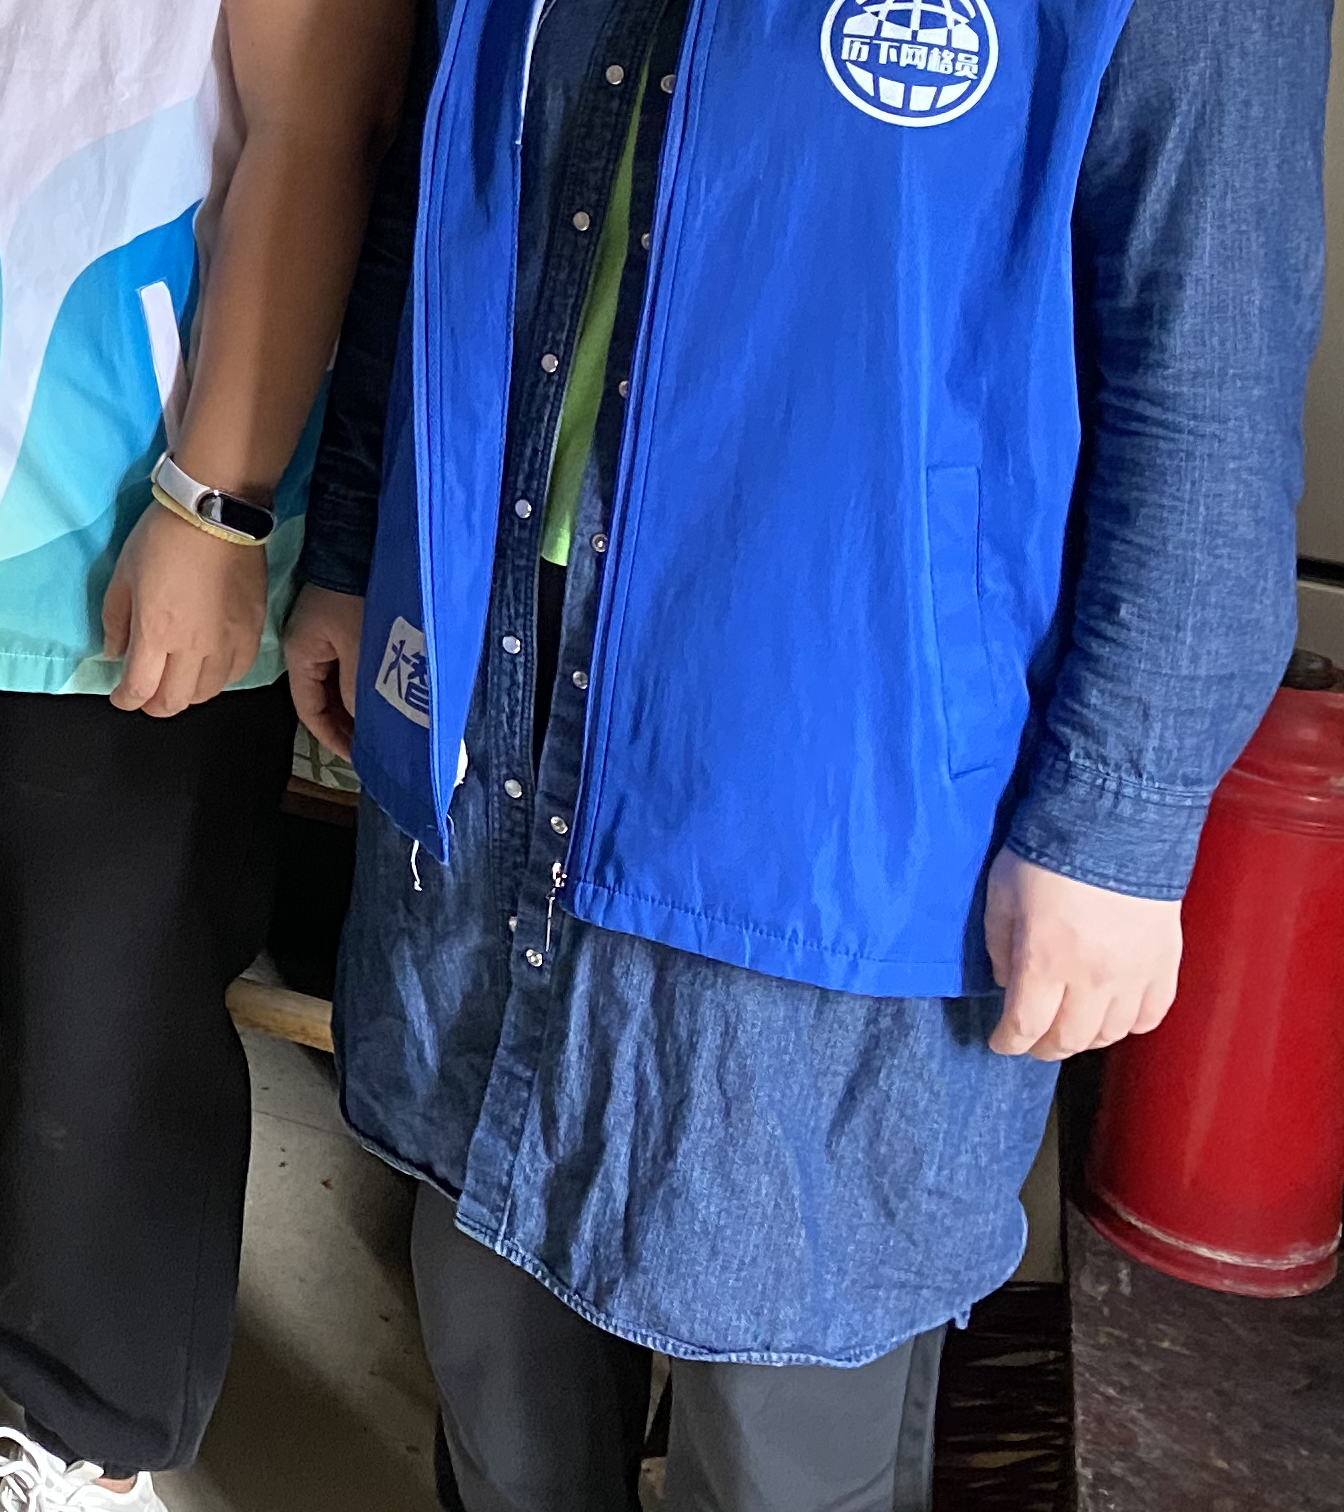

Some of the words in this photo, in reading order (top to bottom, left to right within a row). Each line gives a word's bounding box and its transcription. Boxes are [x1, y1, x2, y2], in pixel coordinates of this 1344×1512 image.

[840, 36, 980, 80] 历下网格员
